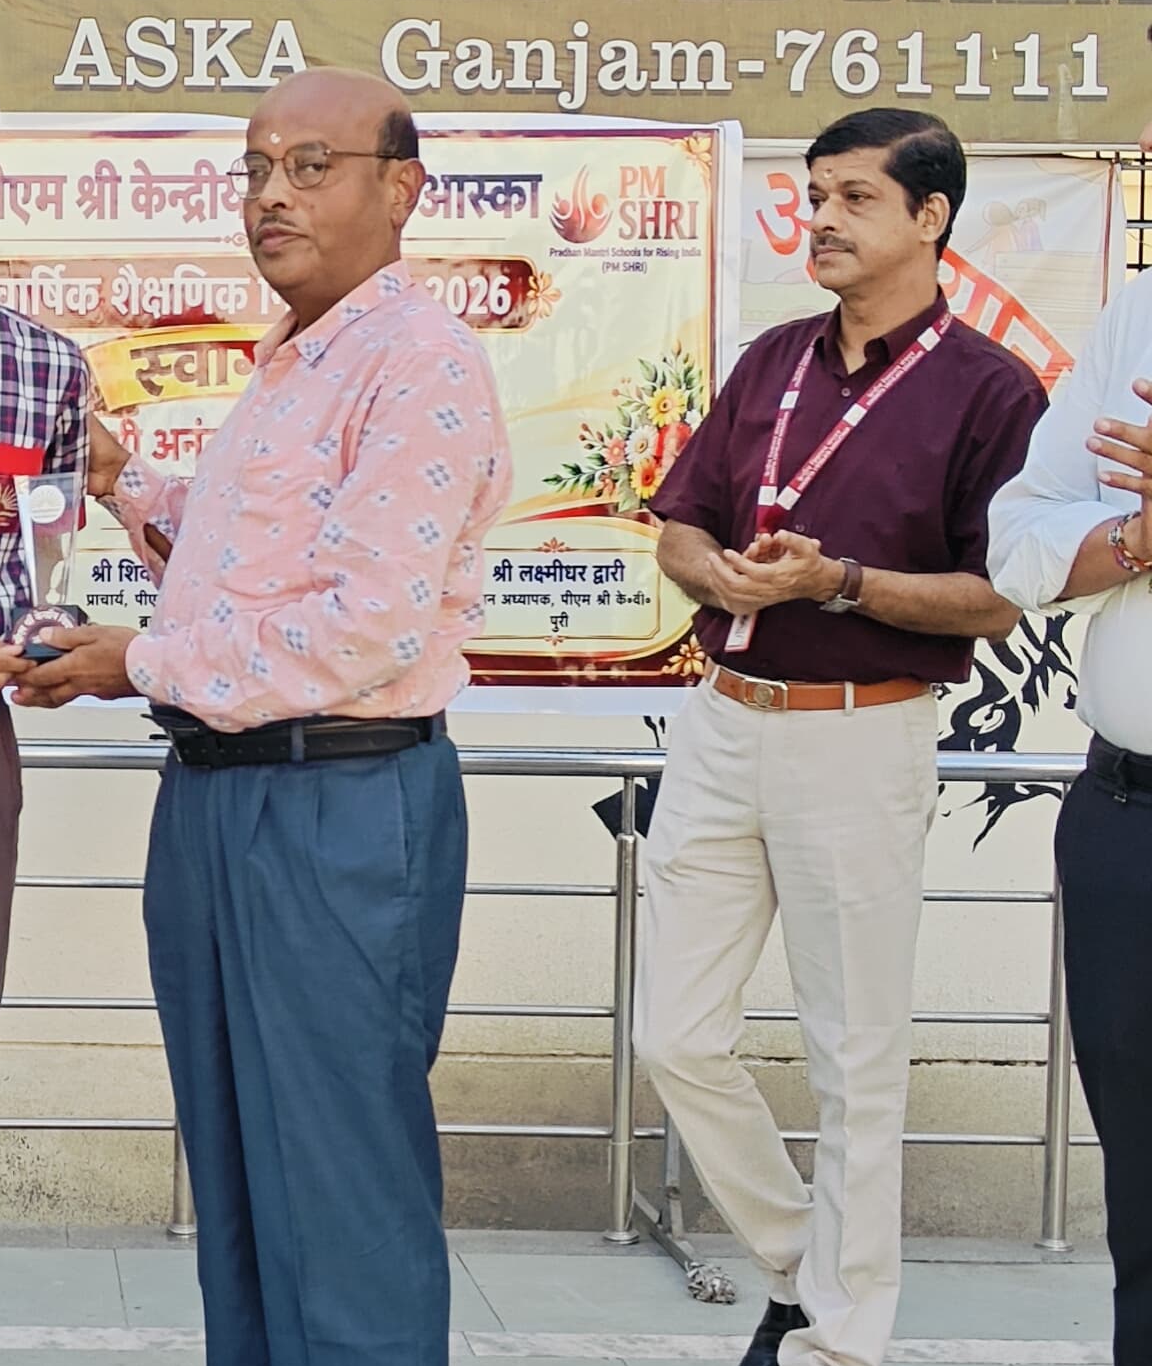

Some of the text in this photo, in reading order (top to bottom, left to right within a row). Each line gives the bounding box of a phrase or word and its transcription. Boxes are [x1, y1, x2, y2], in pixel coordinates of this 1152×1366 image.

[53, 16, 1108, 110] ASKA Ganjam-761111
[76, 159, 122, 219] श्री
[619, 165, 667, 198] PM
[418, 174, 543, 219] आस्का
[618, 200, 699, 240] SHRI
[549, 247, 581, 257] Pradhan
[611, 247, 641, 257] Schools
[643, 247, 654, 257] for
[656, 247, 679, 259] Rising
[602, 261, 648, 273] (PM SHRI)
[110, 263, 250, 319] शैक्षणिक
[91, 558, 112, 582] श्री
[493, 559, 625, 584] श्री लक्ष्मीधर द्वारी
[134, 589, 159, 607] पीए
[560, 590, 590, 607] पीएम
[596, 590, 610, 605] श्री
[550, 611, 568, 632] पुरी
